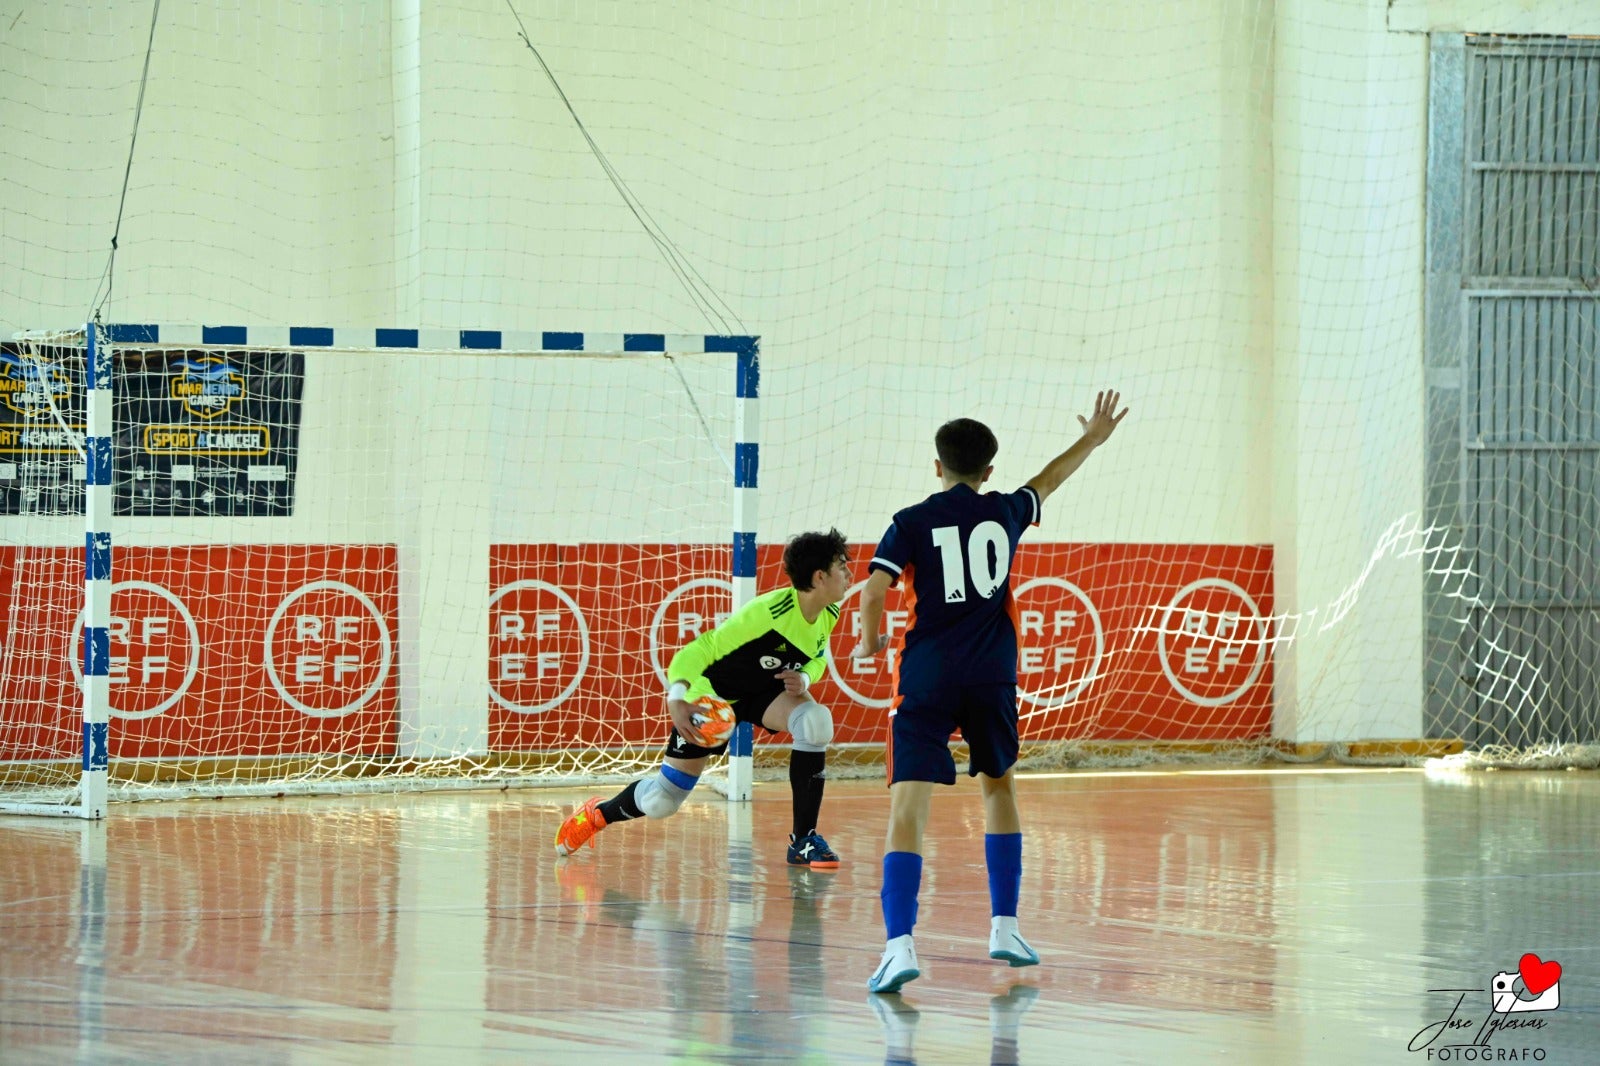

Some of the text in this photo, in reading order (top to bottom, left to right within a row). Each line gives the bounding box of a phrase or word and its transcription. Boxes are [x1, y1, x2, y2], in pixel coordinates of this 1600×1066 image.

[190, 395, 226, 407] GAMES
[932, 521, 1010, 603] 10
[297, 616, 360, 643] RF
[501, 614, 560, 641] RF
[1021, 610, 1077, 636] RF
[1186, 611, 1239, 637] RF
[296, 655, 359, 682] EF
[501, 652, 560, 679] EF
[1021, 647, 1076, 673] EF
[1185, 647, 1239, 673] EF
